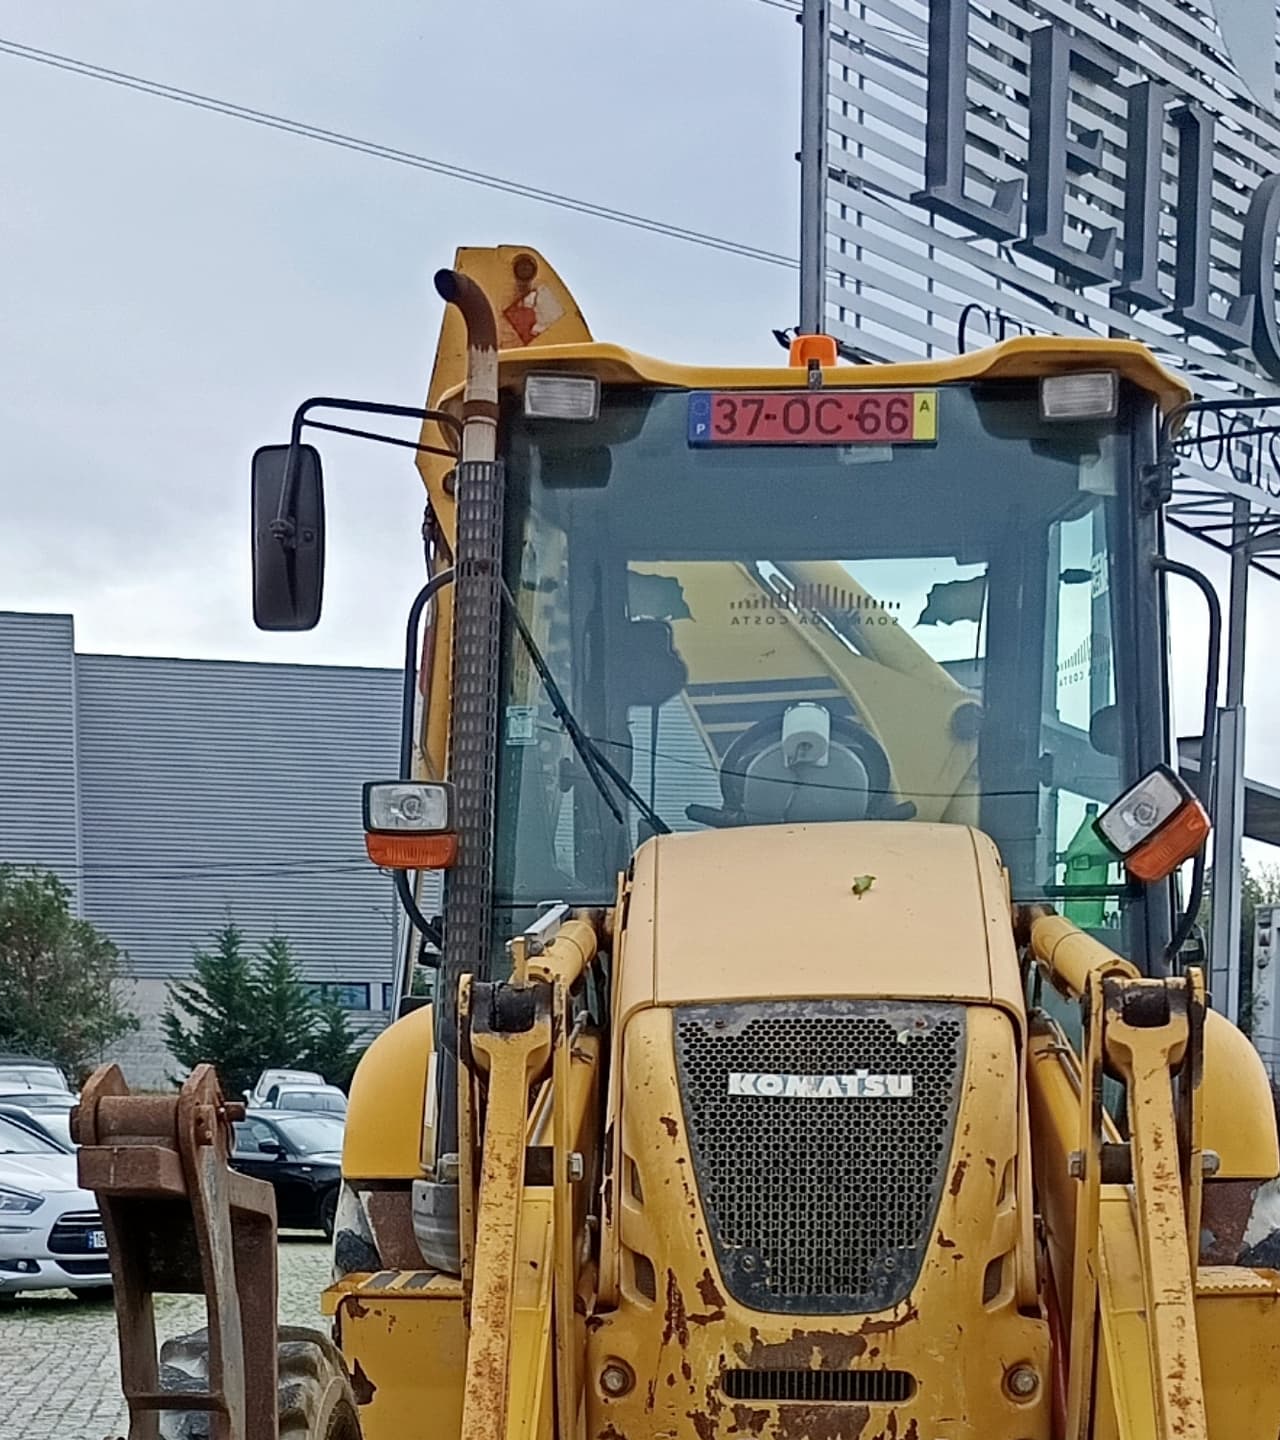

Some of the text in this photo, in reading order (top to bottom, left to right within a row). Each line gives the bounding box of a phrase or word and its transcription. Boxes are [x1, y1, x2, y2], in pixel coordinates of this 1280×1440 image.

[919, 399, 930, 413] A
[696, 423, 705, 434] P
[728, 1069, 913, 1098] KOMATSU
